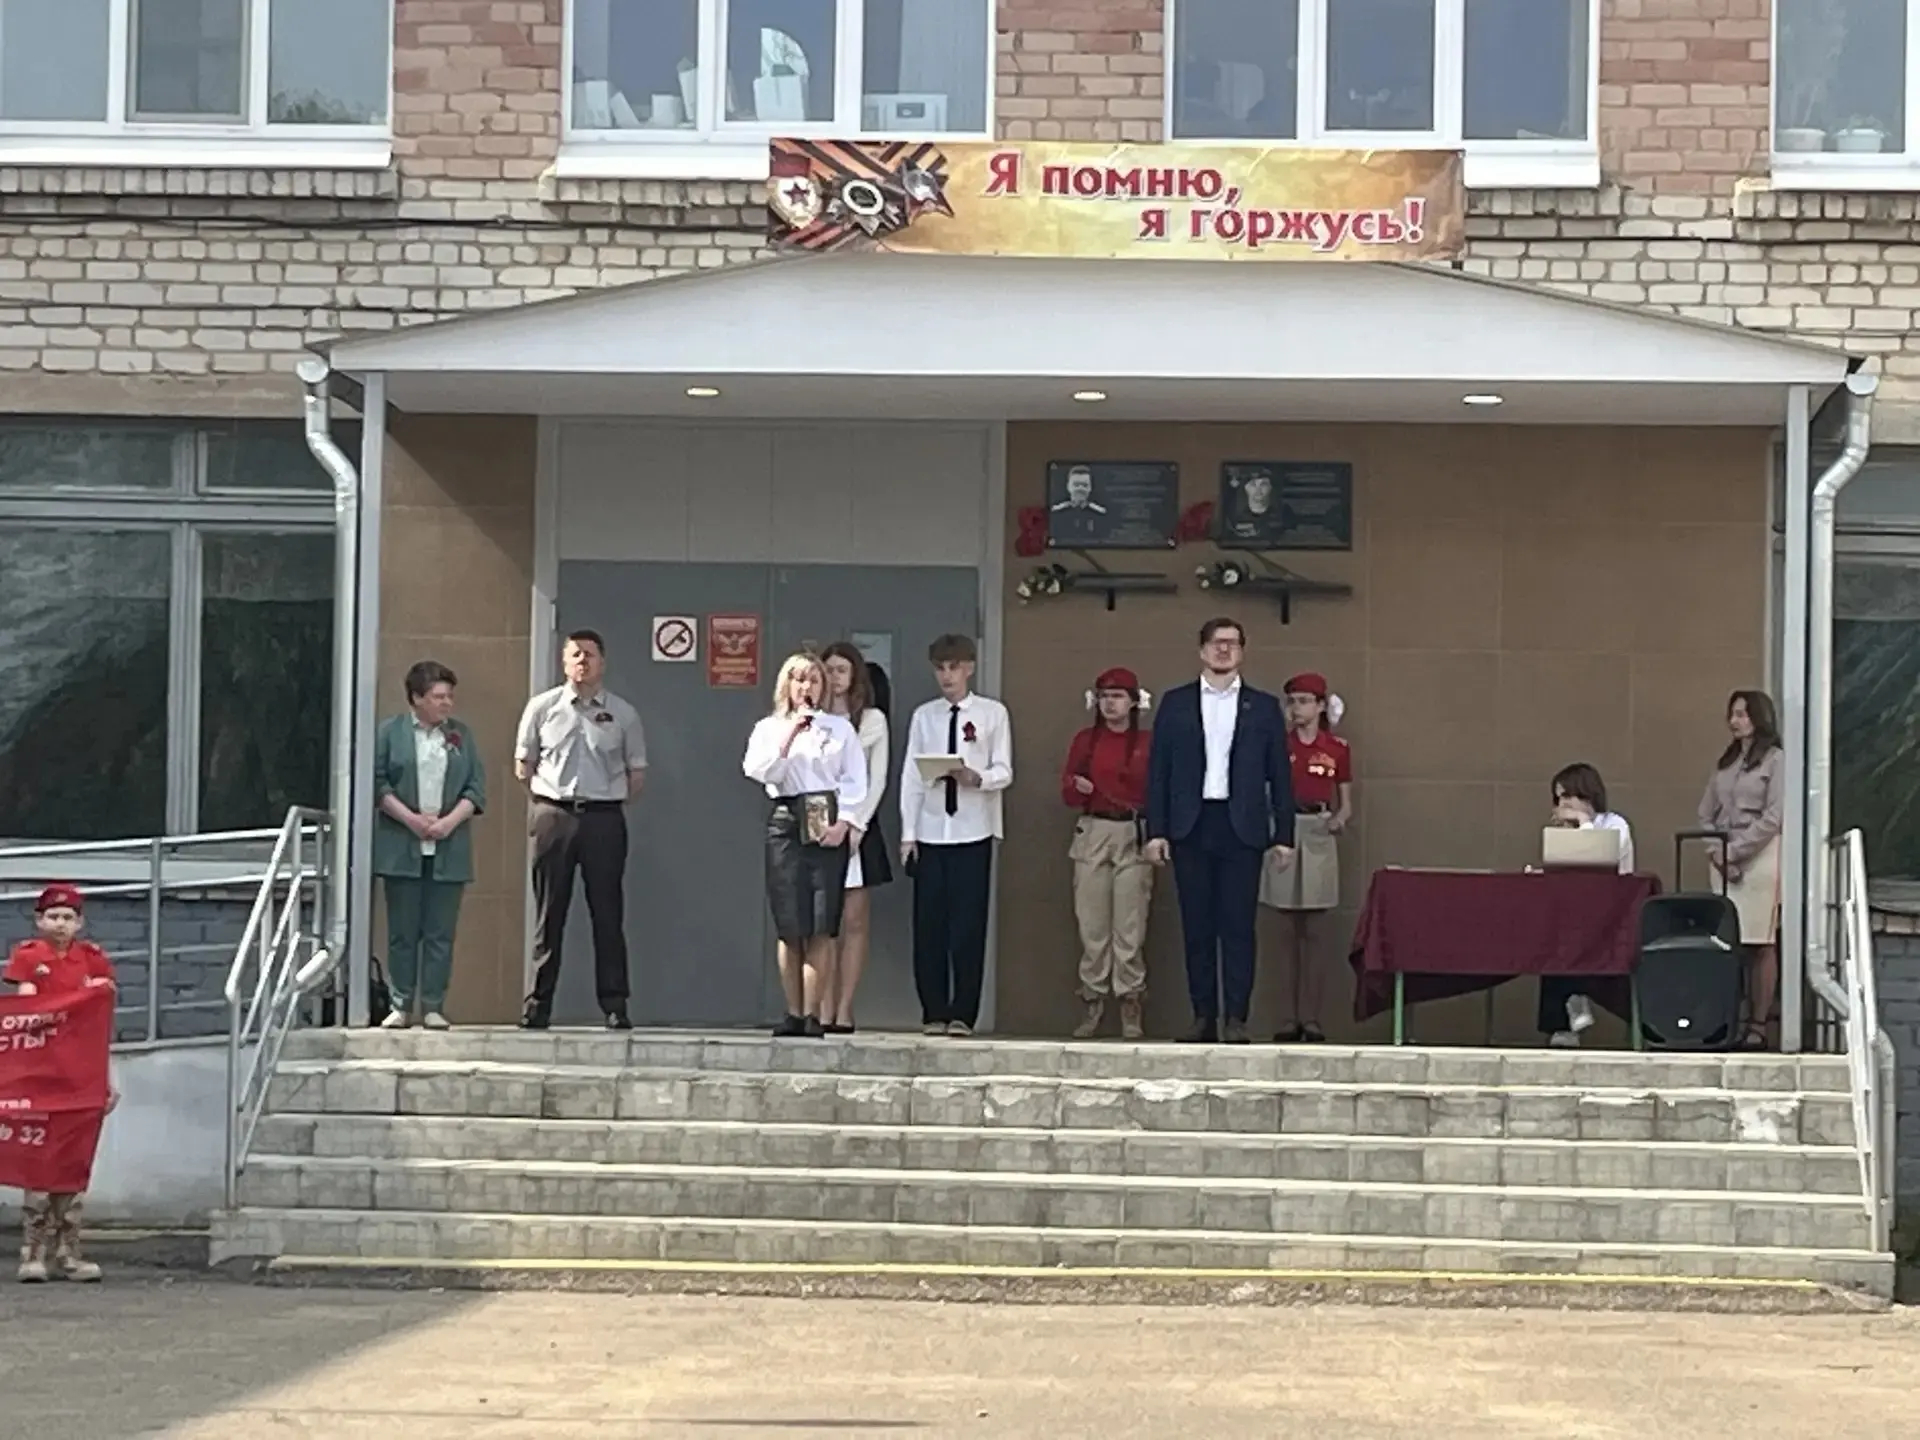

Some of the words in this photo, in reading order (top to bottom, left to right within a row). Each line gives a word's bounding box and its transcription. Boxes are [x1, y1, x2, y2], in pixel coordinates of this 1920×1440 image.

[985, 152, 1019, 194] Я
[1041, 165, 1239, 205] помню,
[1139, 208, 1165, 238] я
[1190, 201, 1420, 248] горжусь!
[19, 1125, 46, 1146] 32
